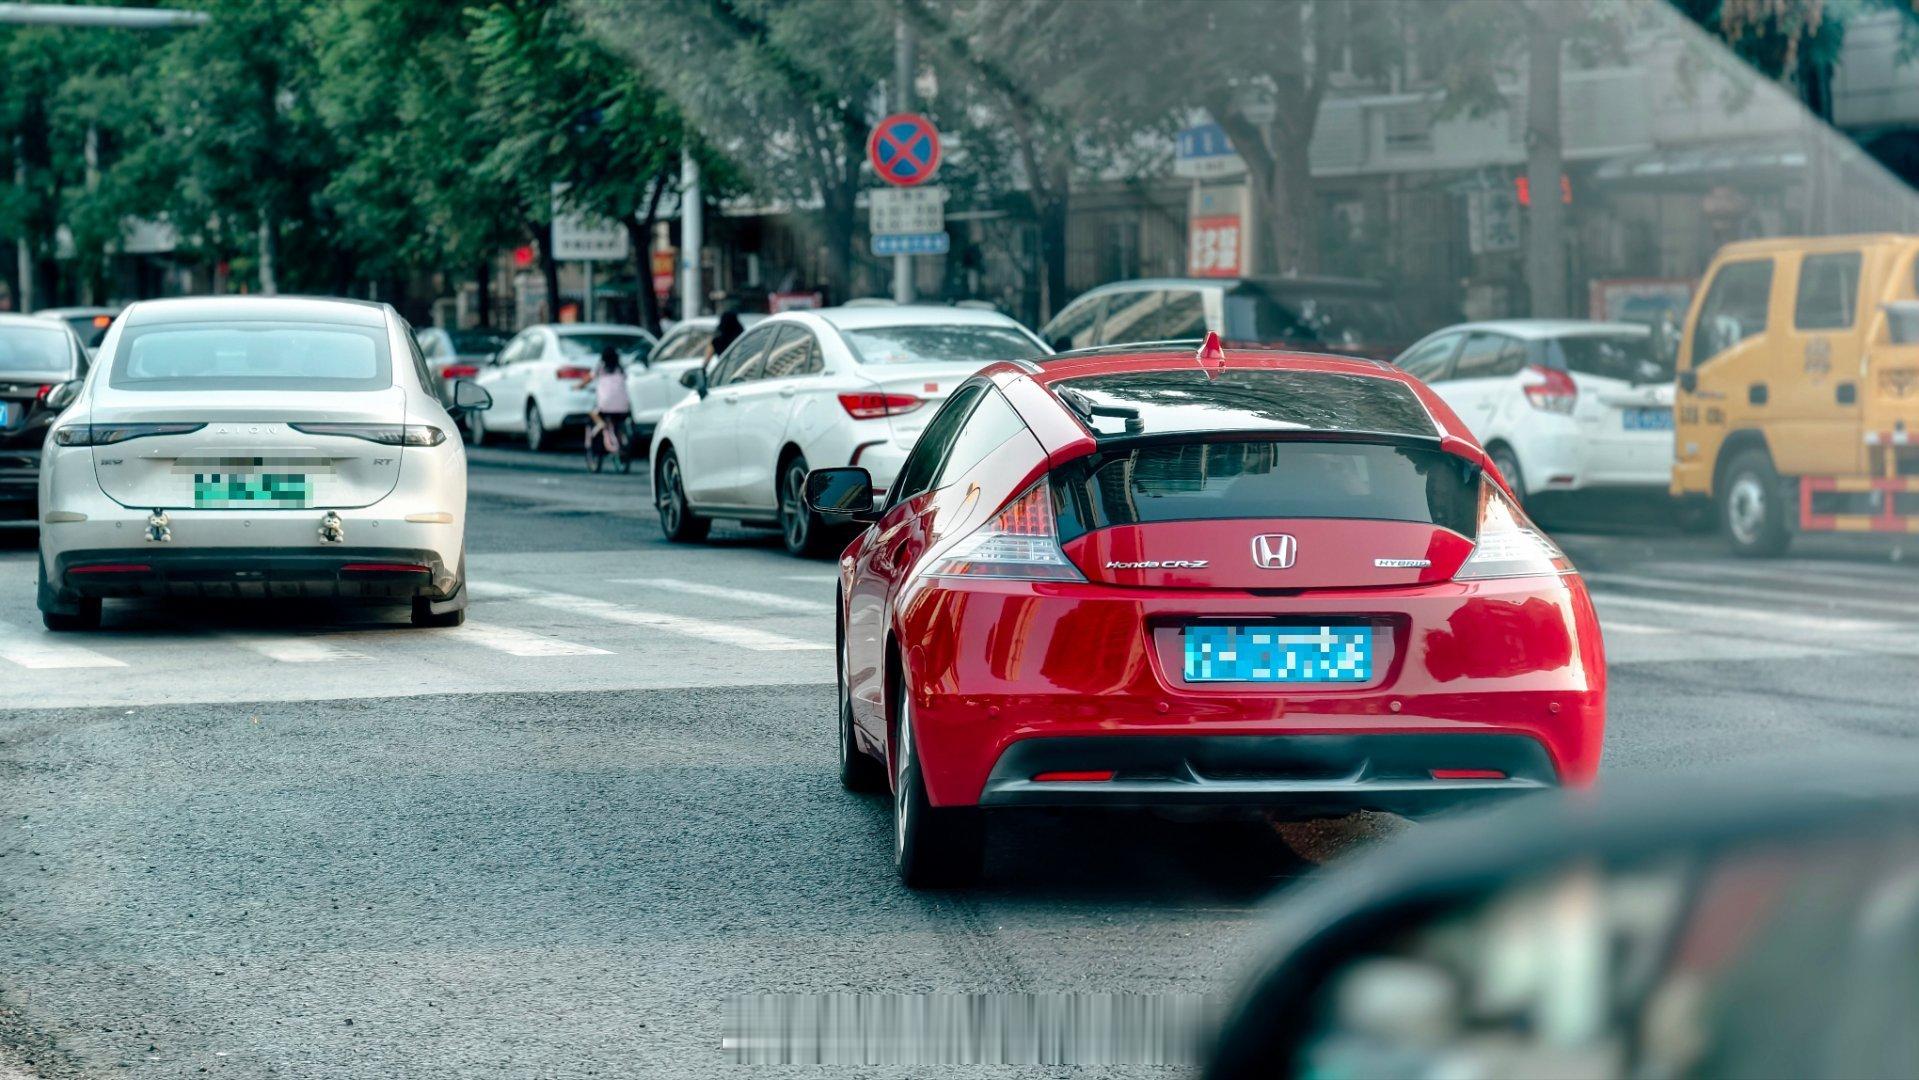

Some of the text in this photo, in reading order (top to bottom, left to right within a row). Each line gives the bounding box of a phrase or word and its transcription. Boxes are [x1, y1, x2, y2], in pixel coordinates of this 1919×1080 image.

[217, 426, 277, 434] AION
[1105, 560, 1208, 569] Honda CR-Z
[1378, 559, 1430, 567] HYBRID
